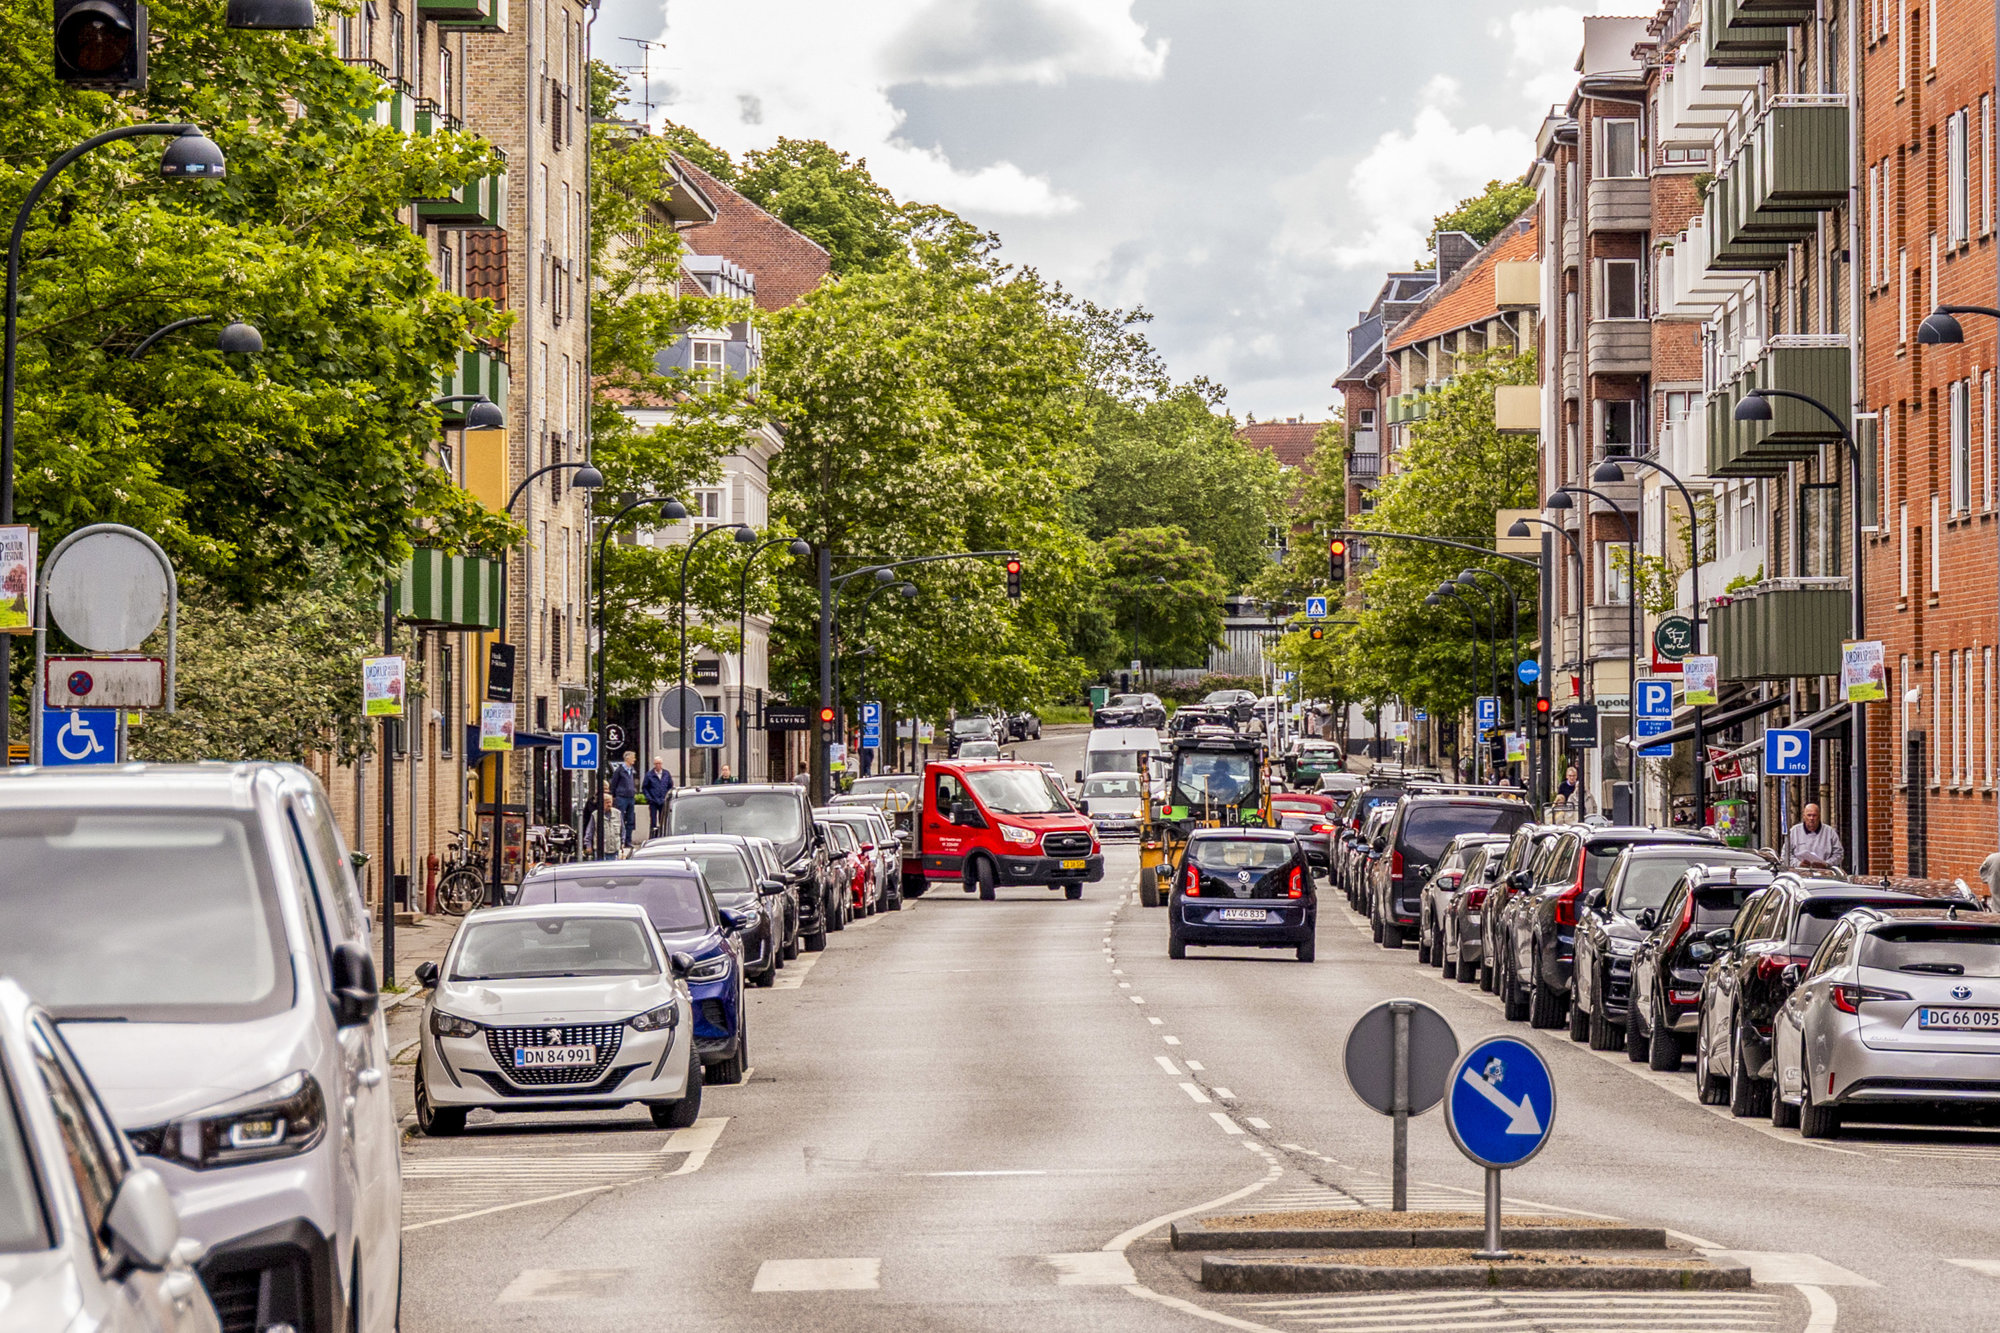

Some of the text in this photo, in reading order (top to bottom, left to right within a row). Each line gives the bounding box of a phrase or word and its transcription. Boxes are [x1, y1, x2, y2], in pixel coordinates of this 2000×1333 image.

[1646, 685, 1666, 713] P
[863, 706, 876, 723] P
[1483, 701, 1495, 718] P
[571, 737, 592, 766] P
[1776, 734, 1802, 770] P
[1789, 762, 1807, 770] info
[1225, 909, 1266, 918] AV 46 835
[1929, 1010, 1999, 1026] DG 66 095
[525, 1048, 592, 1064] DN 84 991
